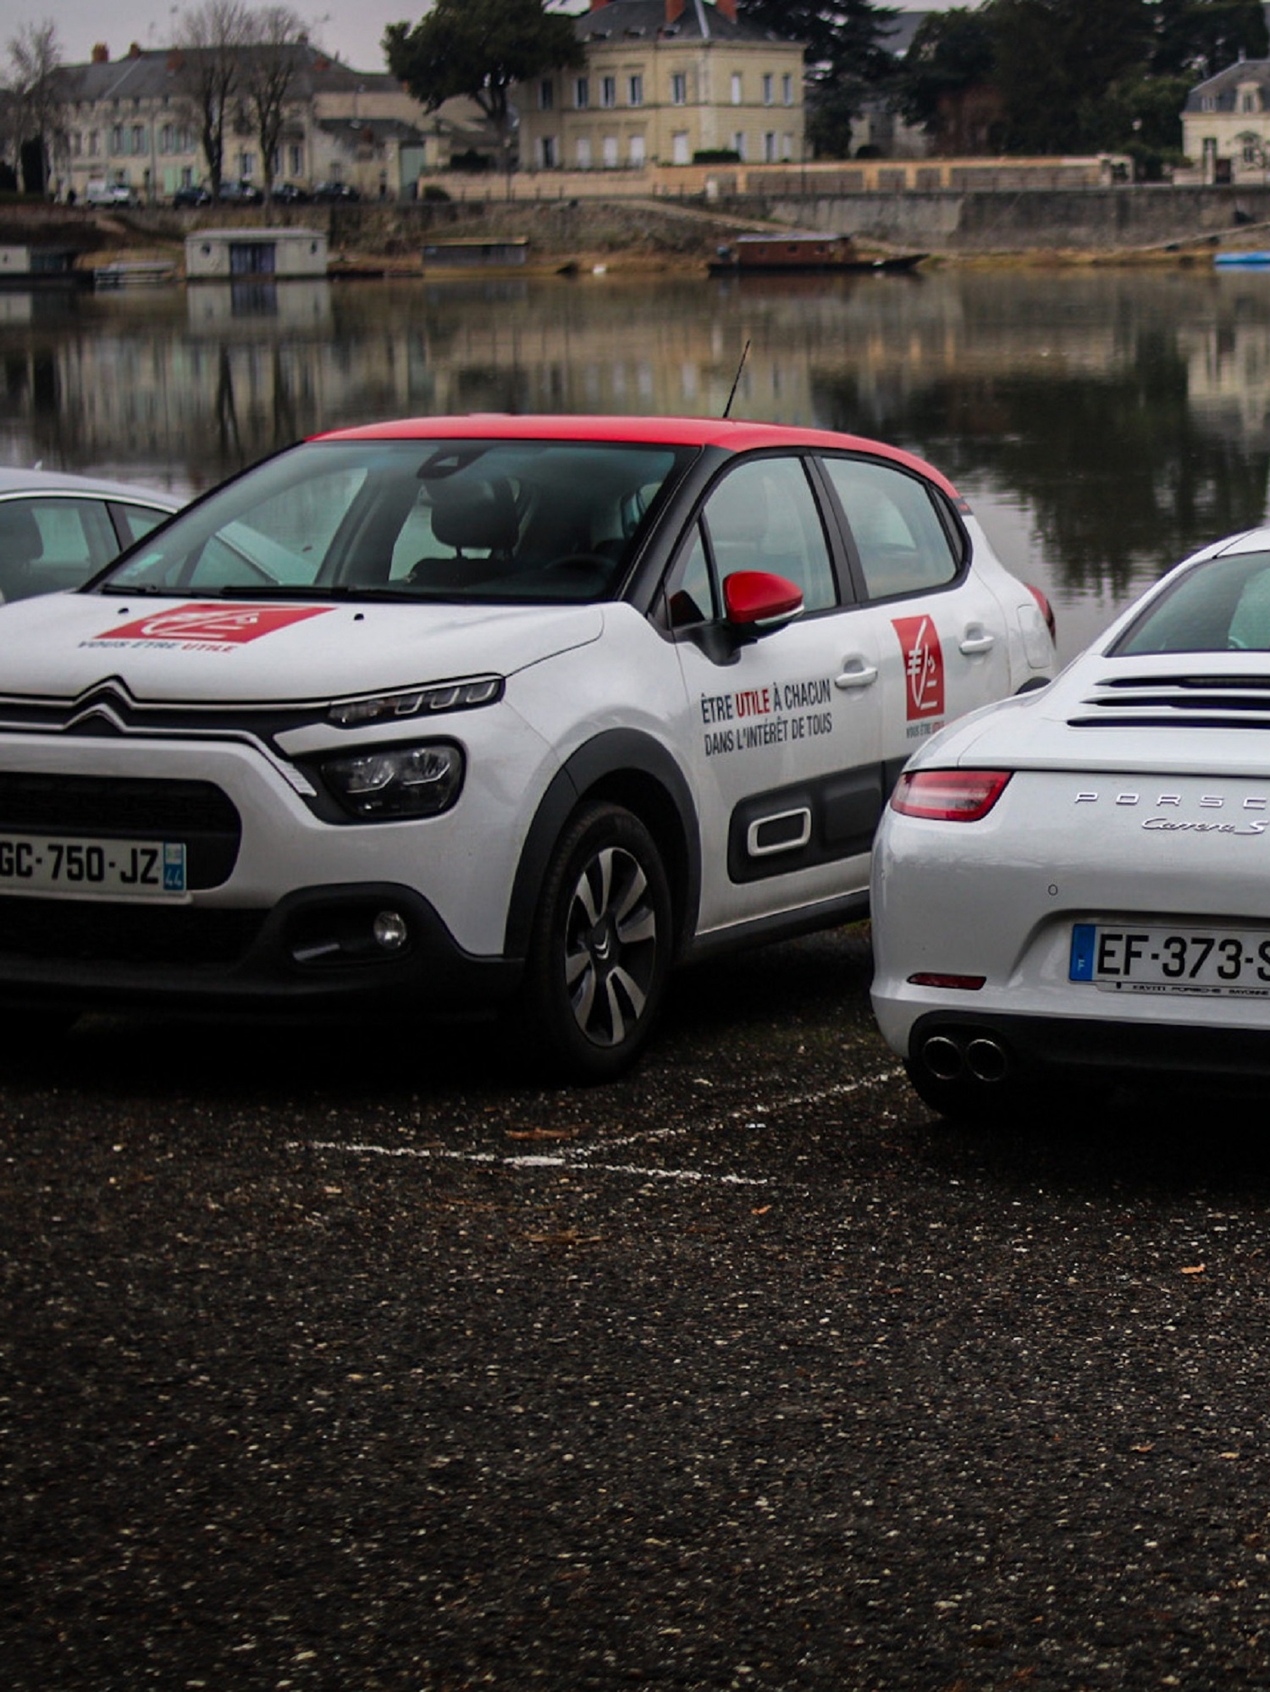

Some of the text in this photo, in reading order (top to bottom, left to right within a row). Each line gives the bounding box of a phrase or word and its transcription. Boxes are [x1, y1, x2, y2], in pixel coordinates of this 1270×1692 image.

[181, 642, 238, 653] UTILE
[700, 678, 831, 725] ÊTRE UTILE À CHACUN
[704, 712, 833, 757] DANS L'INTÉRÊT DE TOUS
[1141, 817, 1270, 835] Carrera S
[1077, 959, 1085, 971] F
[1171, 986, 1221, 994] PORSCHE
